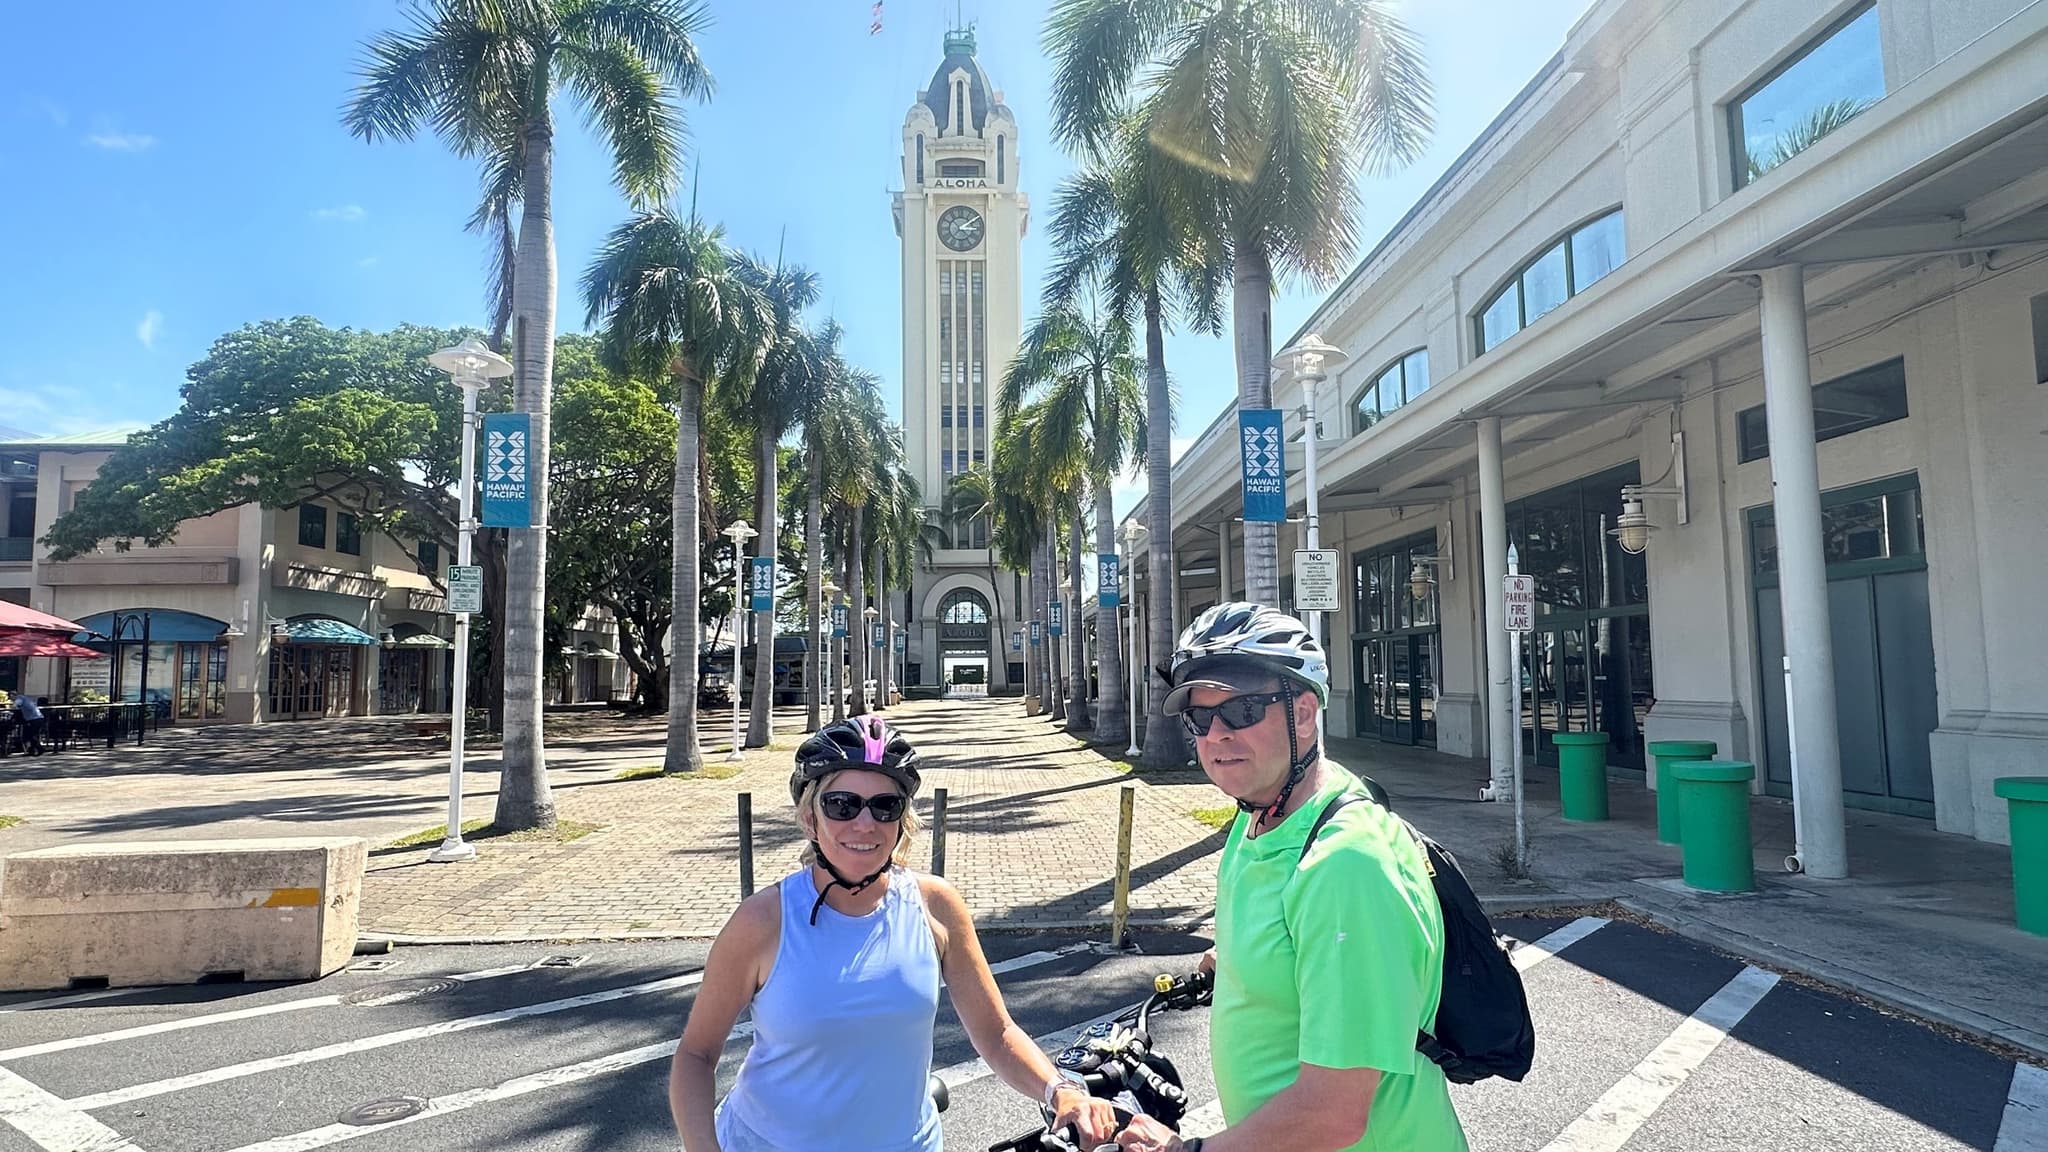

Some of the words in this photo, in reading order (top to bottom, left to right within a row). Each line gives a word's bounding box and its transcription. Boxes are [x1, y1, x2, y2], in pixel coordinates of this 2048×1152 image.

[935, 179, 987, 188] ALOHA
[486, 490, 526, 499] PACIFIC
[1247, 485, 1281, 493] PACIFIC
[1308, 553, 1323, 561] NO
[450, 567, 460, 580] 15
[1513, 579, 1525, 591] NO
[1504, 591, 1533, 603] PARKING
[1510, 604, 1527, 616] FIRE
[1508, 616, 1529, 628] LANE
